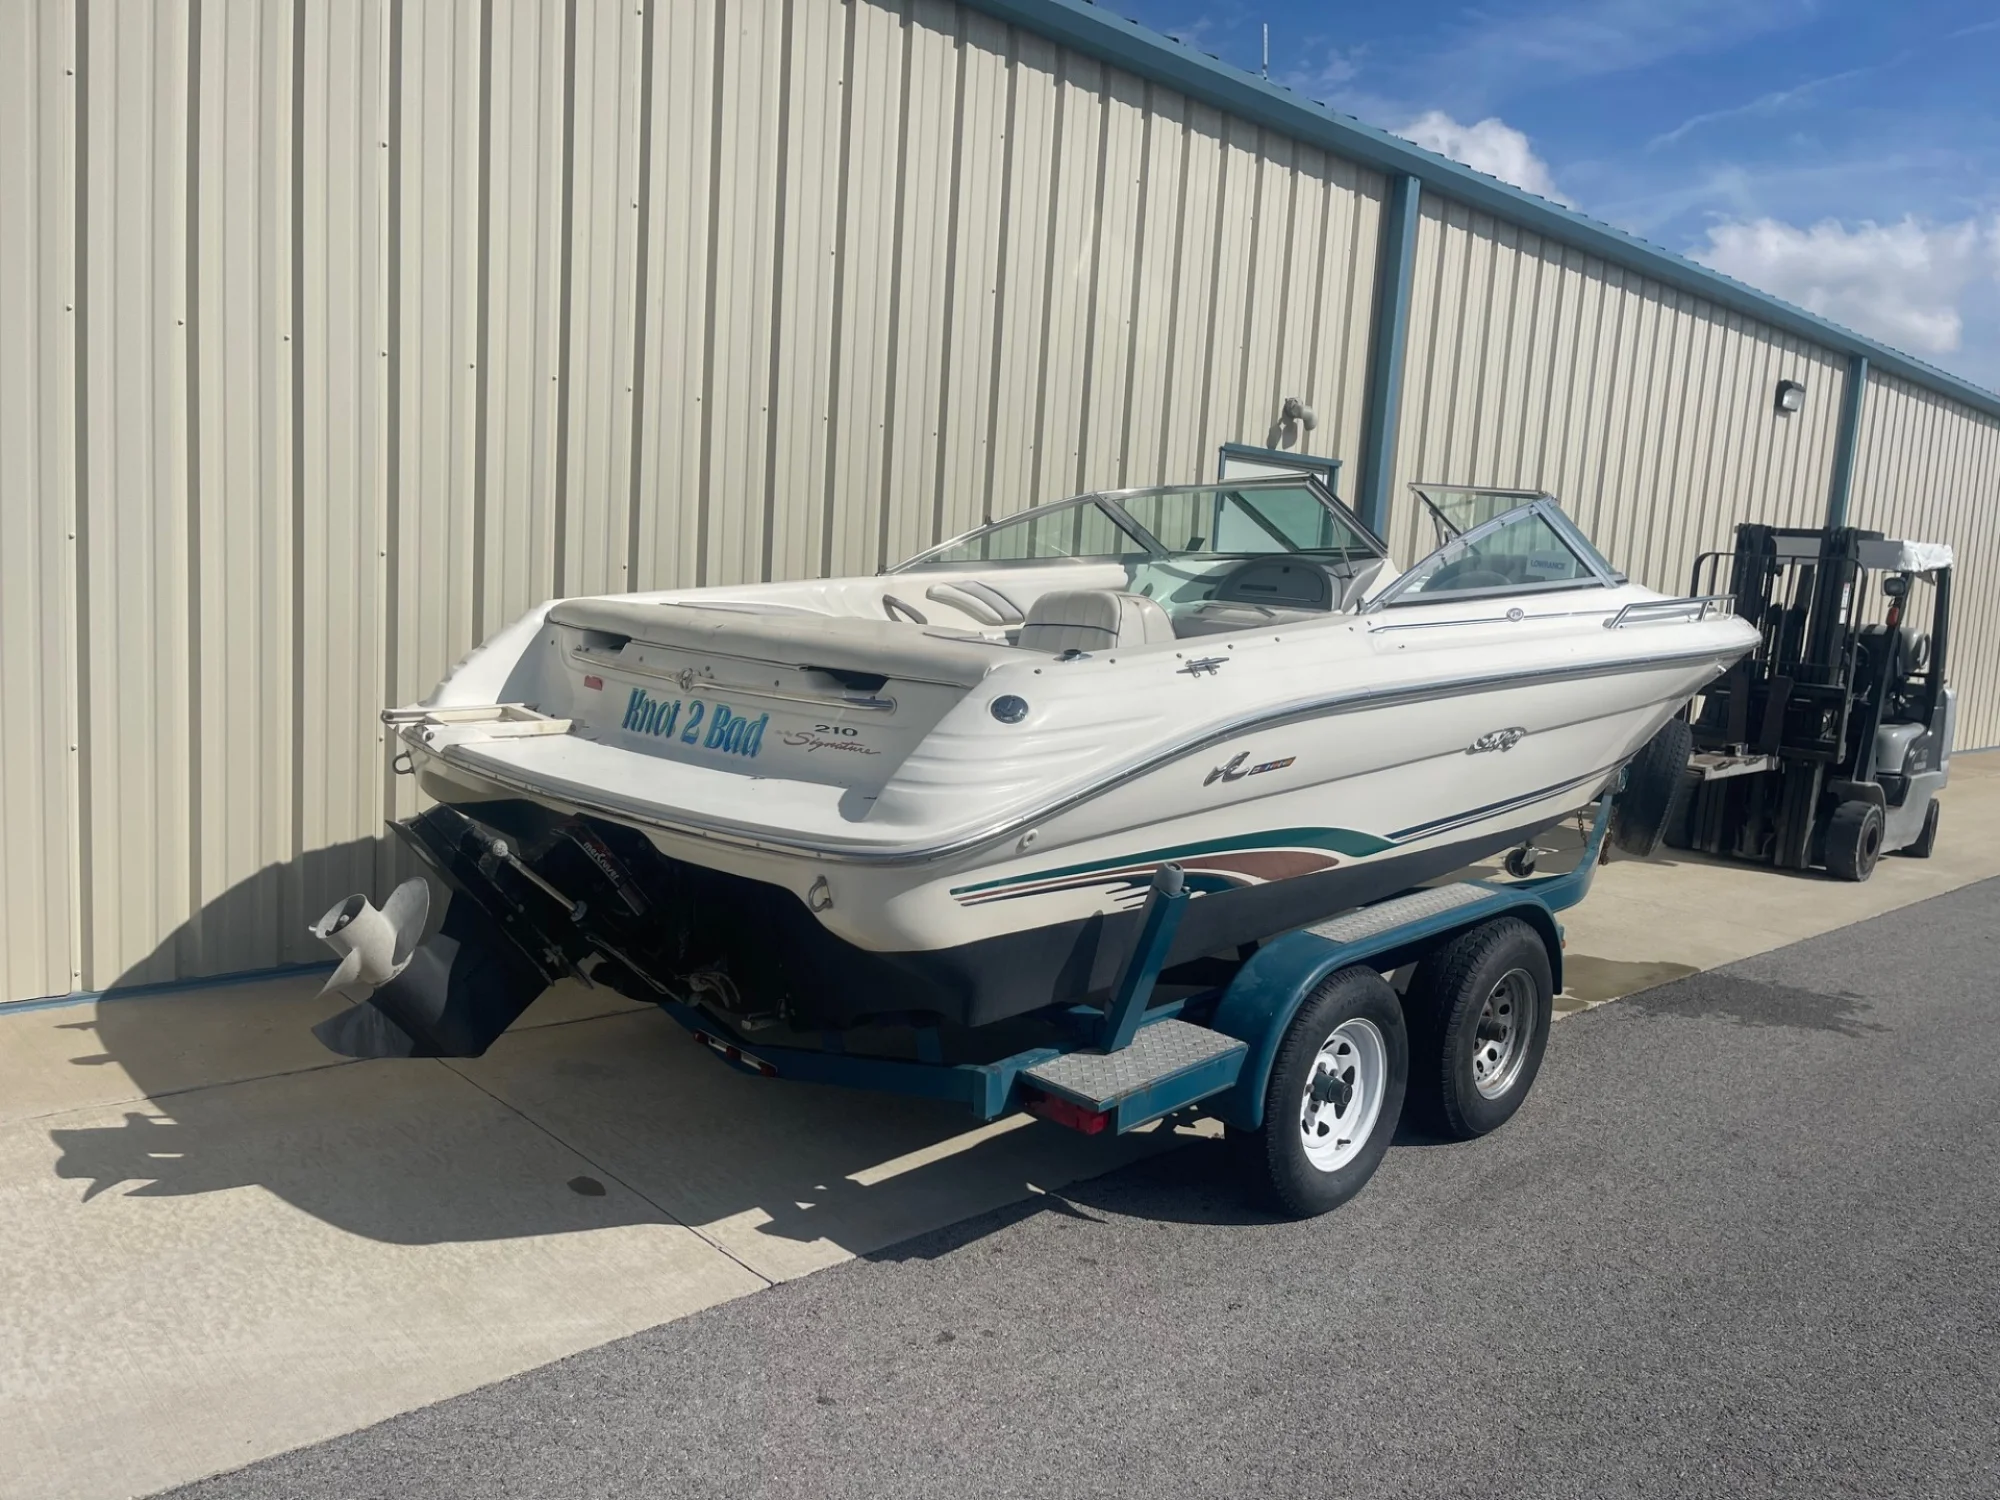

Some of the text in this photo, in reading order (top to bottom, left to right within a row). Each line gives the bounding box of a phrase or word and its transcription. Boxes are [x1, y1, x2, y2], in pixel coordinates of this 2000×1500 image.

[1531, 559, 1566, 570] LOWRANCE
[622, 687, 770, 758] Knot 2 Bad
[814, 724, 858, 737] 210
[782, 731, 881, 755] Signature
